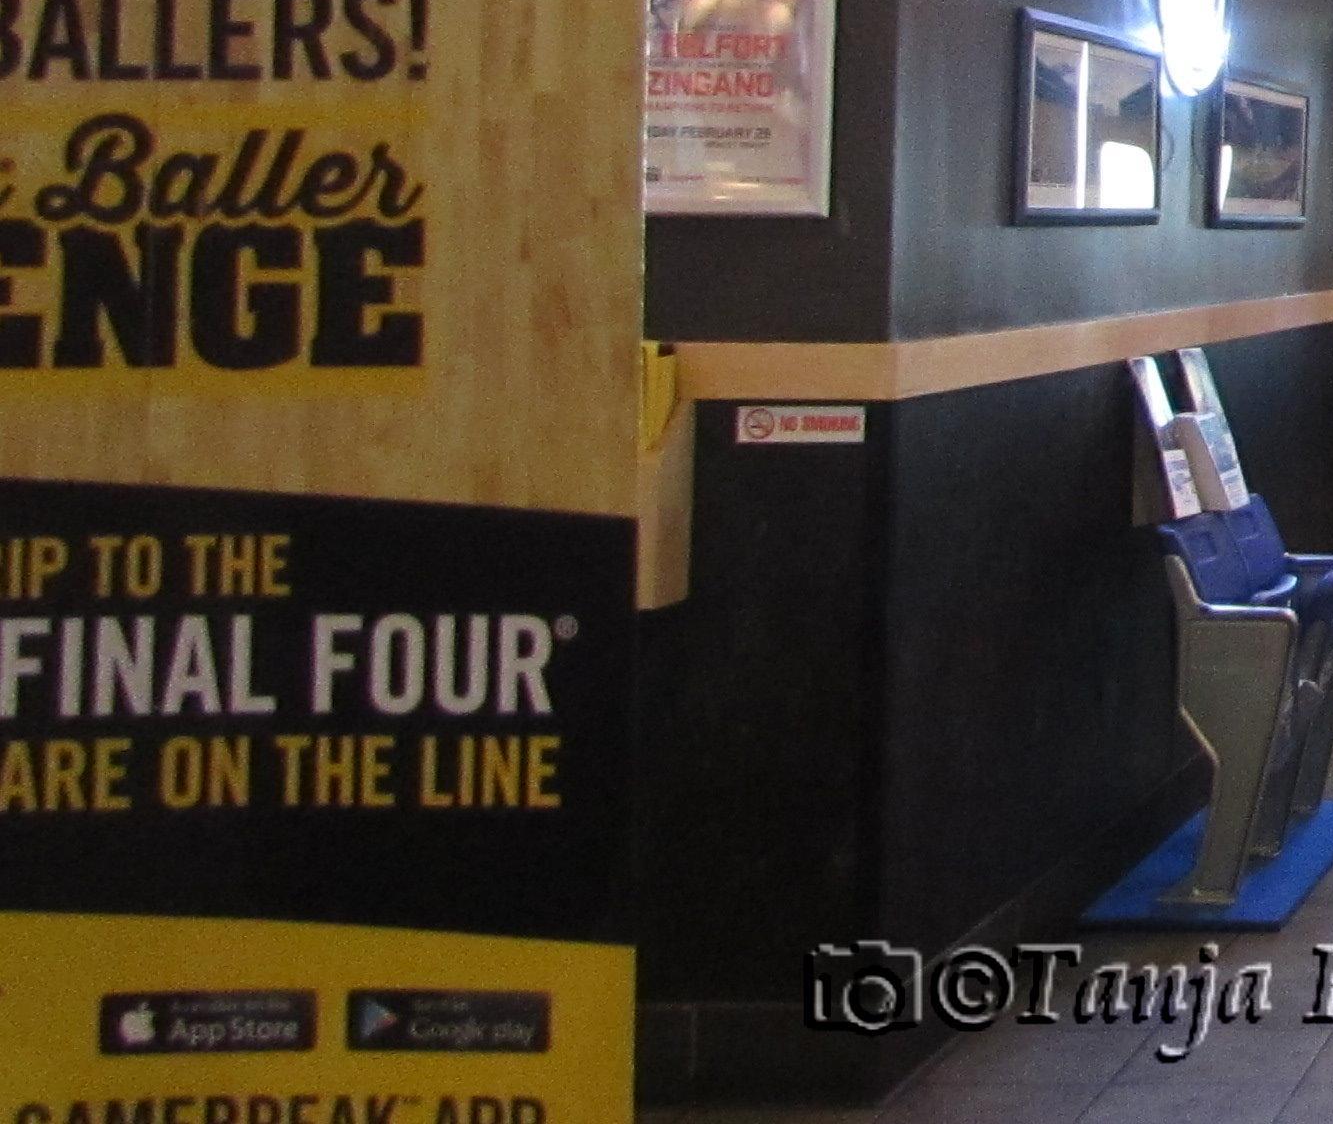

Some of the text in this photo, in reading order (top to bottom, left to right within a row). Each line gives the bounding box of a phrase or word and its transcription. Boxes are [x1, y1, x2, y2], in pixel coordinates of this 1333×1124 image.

[648, 71, 775, 98] ZINGANO
[34, 113, 426, 224] Baller
[780, 415, 799, 432] NO
[92, 535, 163, 597] TO
[187, 534, 291, 597] THE
[0, 616, 277, 717] FINAL
[0, 736, 562, 813] ARE ON THE LINE
[168, 1016, 298, 1047] App Store
